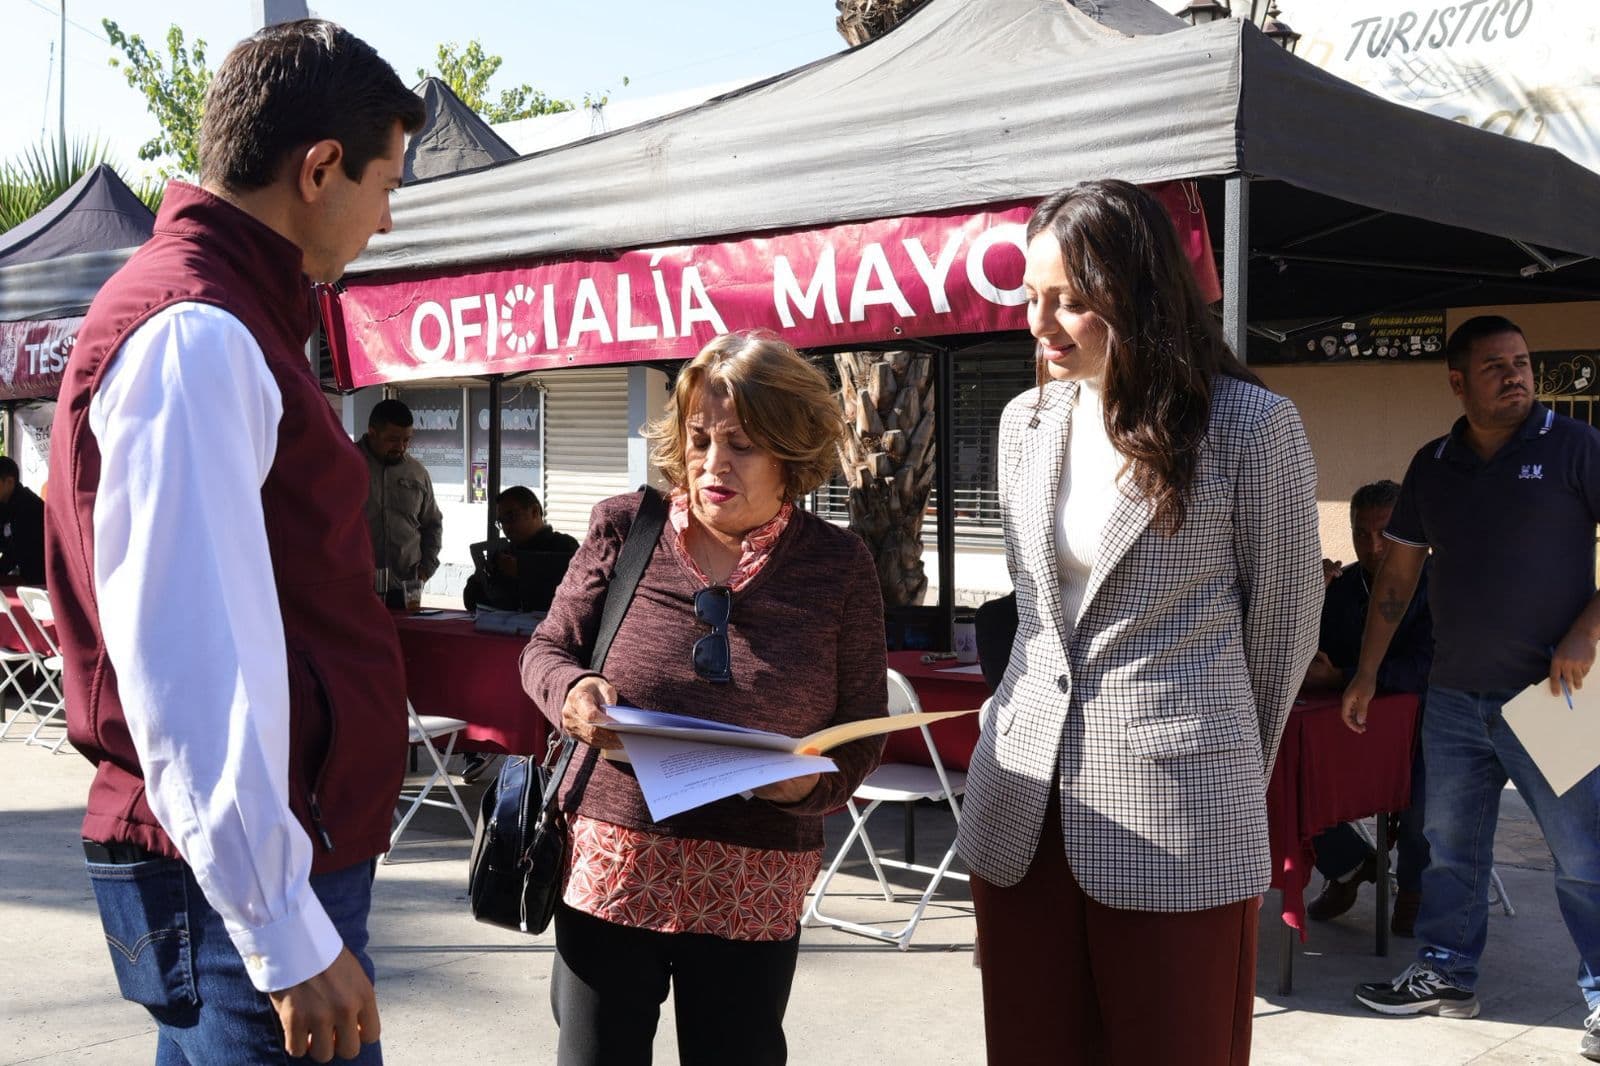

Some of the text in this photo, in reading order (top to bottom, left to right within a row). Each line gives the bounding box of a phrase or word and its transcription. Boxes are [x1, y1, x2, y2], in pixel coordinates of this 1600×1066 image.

[1344, 0, 1533, 61] TURISTICO
[410, 223, 1028, 363] OFICIALÍA MAYO
